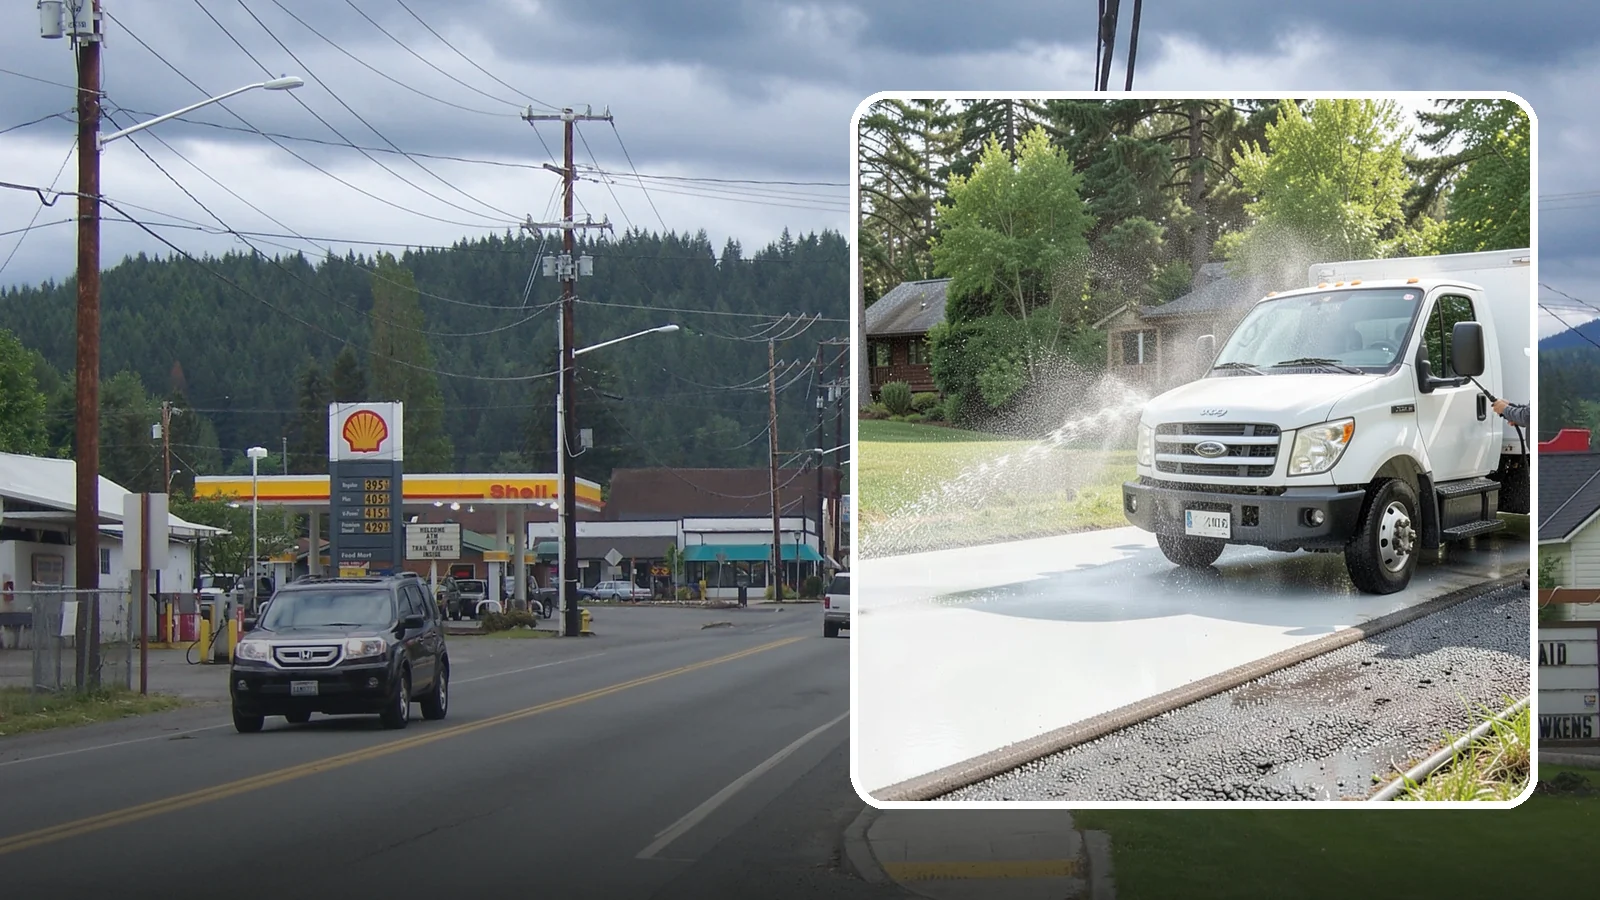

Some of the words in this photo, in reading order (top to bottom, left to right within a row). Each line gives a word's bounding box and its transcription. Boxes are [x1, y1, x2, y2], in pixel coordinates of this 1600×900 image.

[342, 482, 358, 490] Regular
[366, 480, 383, 490] 395
[490, 484, 547, 499] Shell
[366, 494, 383, 504] 405
[366, 508, 383, 518] 415
[366, 522, 383, 532] 429
[1538, 643, 1566, 665] AID
